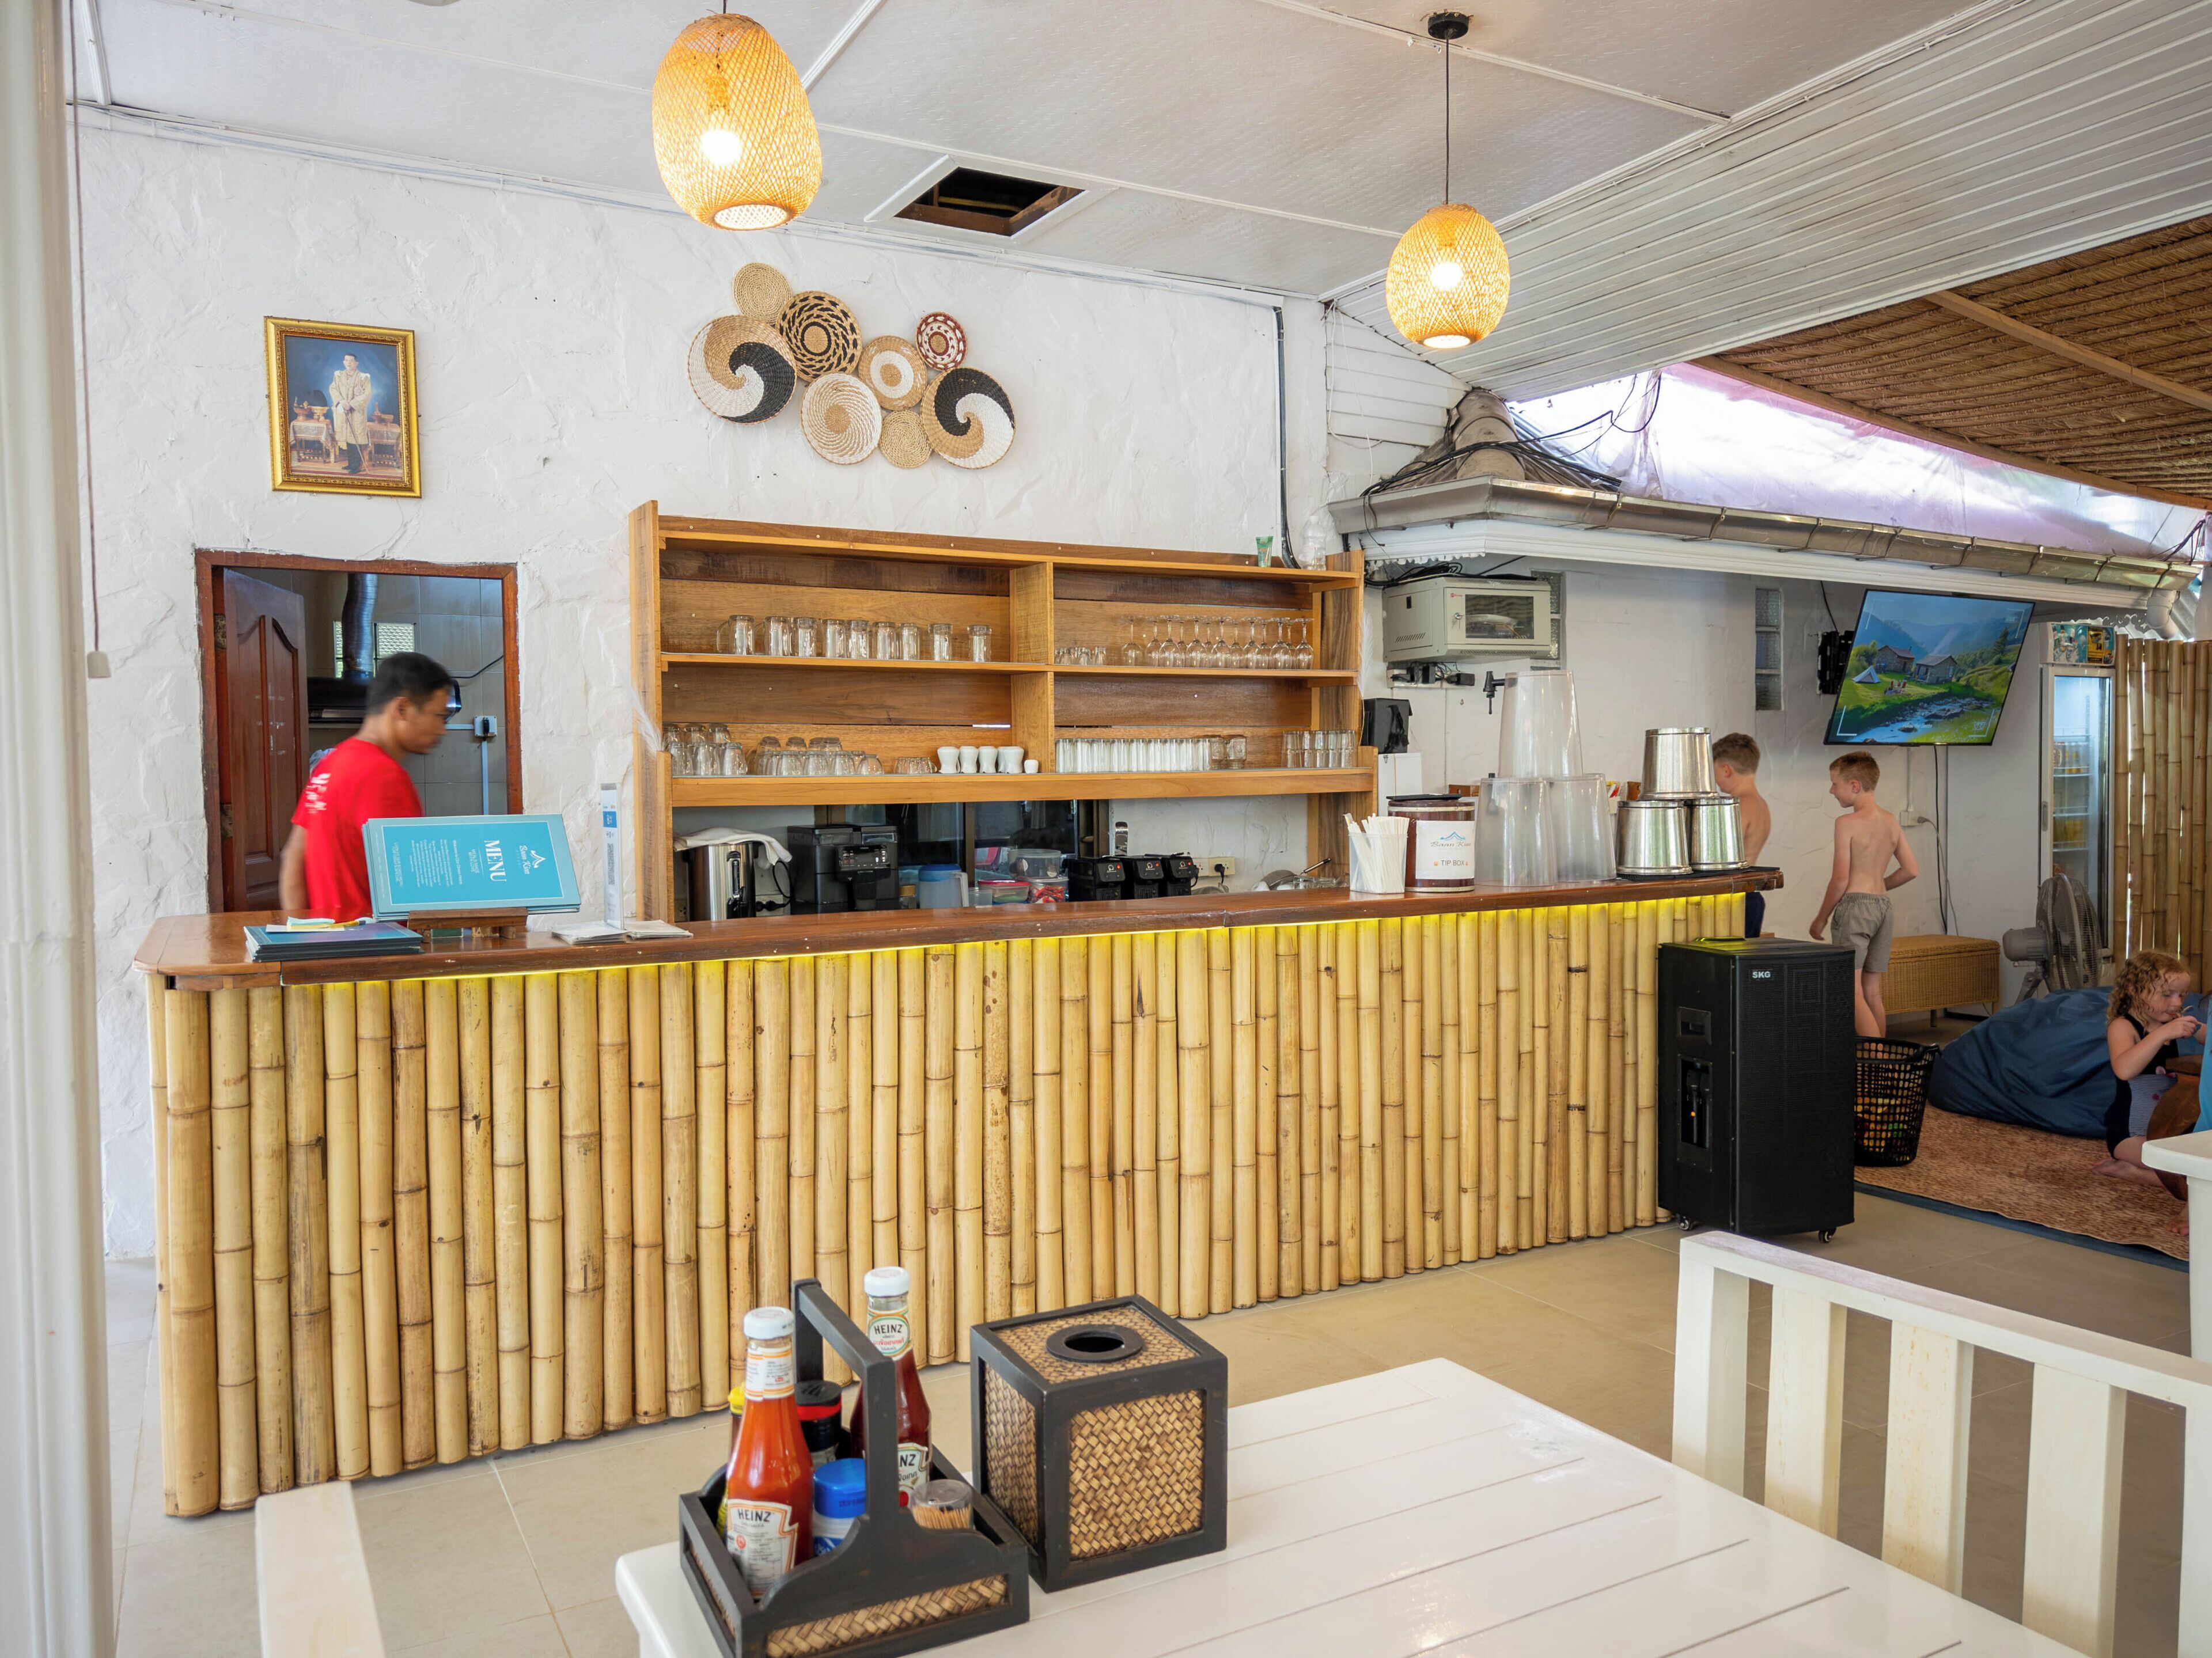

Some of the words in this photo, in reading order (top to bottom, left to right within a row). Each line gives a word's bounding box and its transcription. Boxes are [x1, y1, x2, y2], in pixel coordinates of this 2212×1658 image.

[484, 840, 507, 882] MENU
[874, 1324, 903, 1334] HEINZ
[738, 1508, 771, 1522] HEINZ
